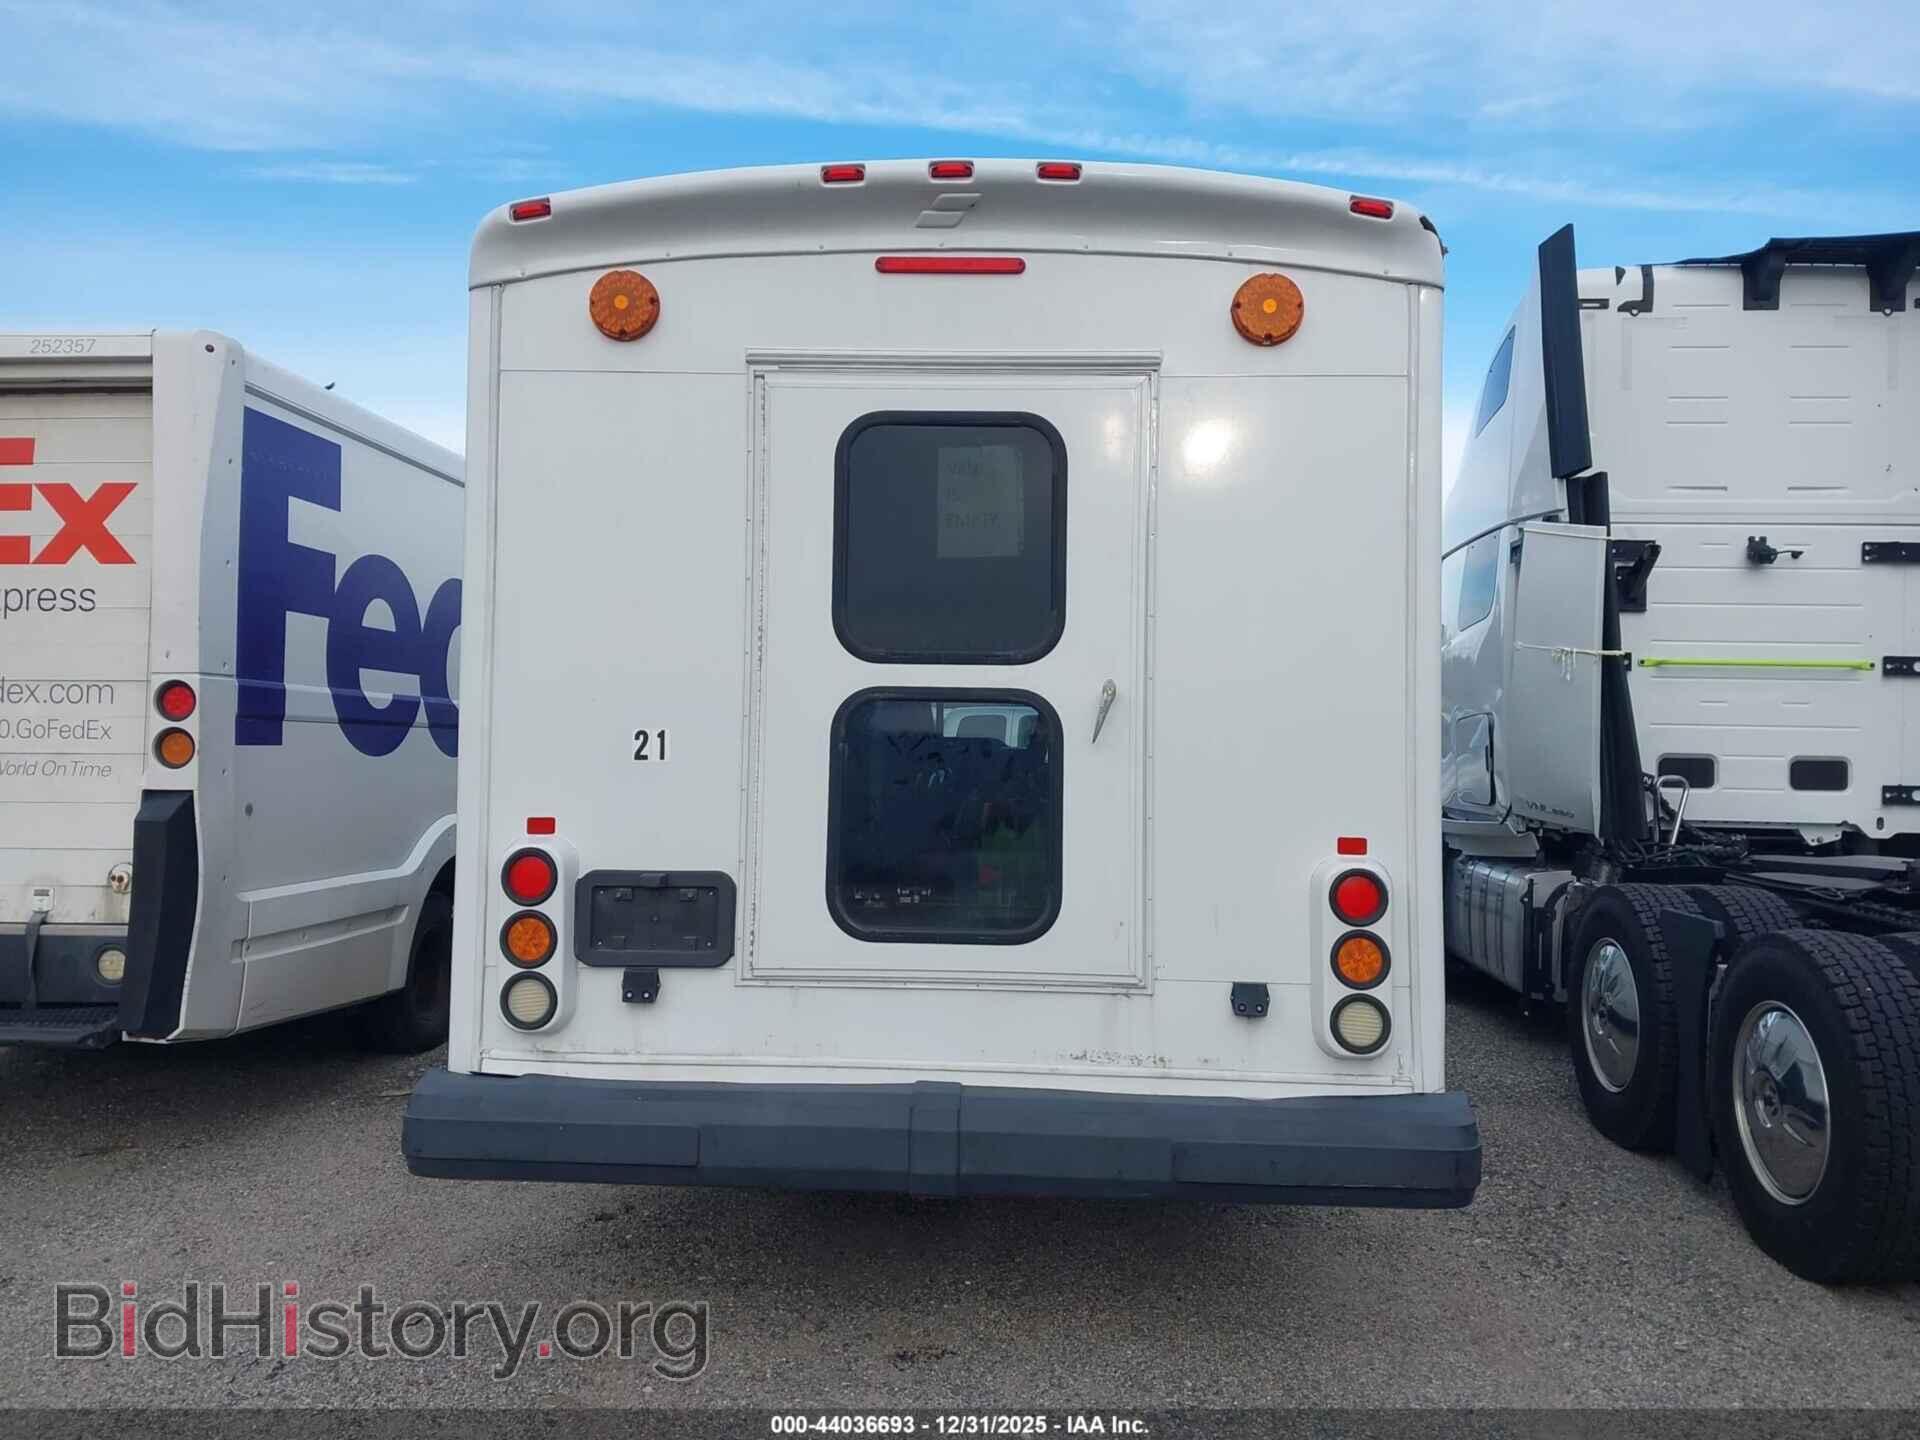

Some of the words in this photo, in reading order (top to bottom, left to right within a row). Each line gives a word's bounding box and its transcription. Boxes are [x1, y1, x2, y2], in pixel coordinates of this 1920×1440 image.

[30, 338, 96, 354] 252357
[0, 588, 96, 619] press
[633, 729, 666, 761] 21
[42, 760, 67, 777] On
[70, 760, 112, 777] Time
